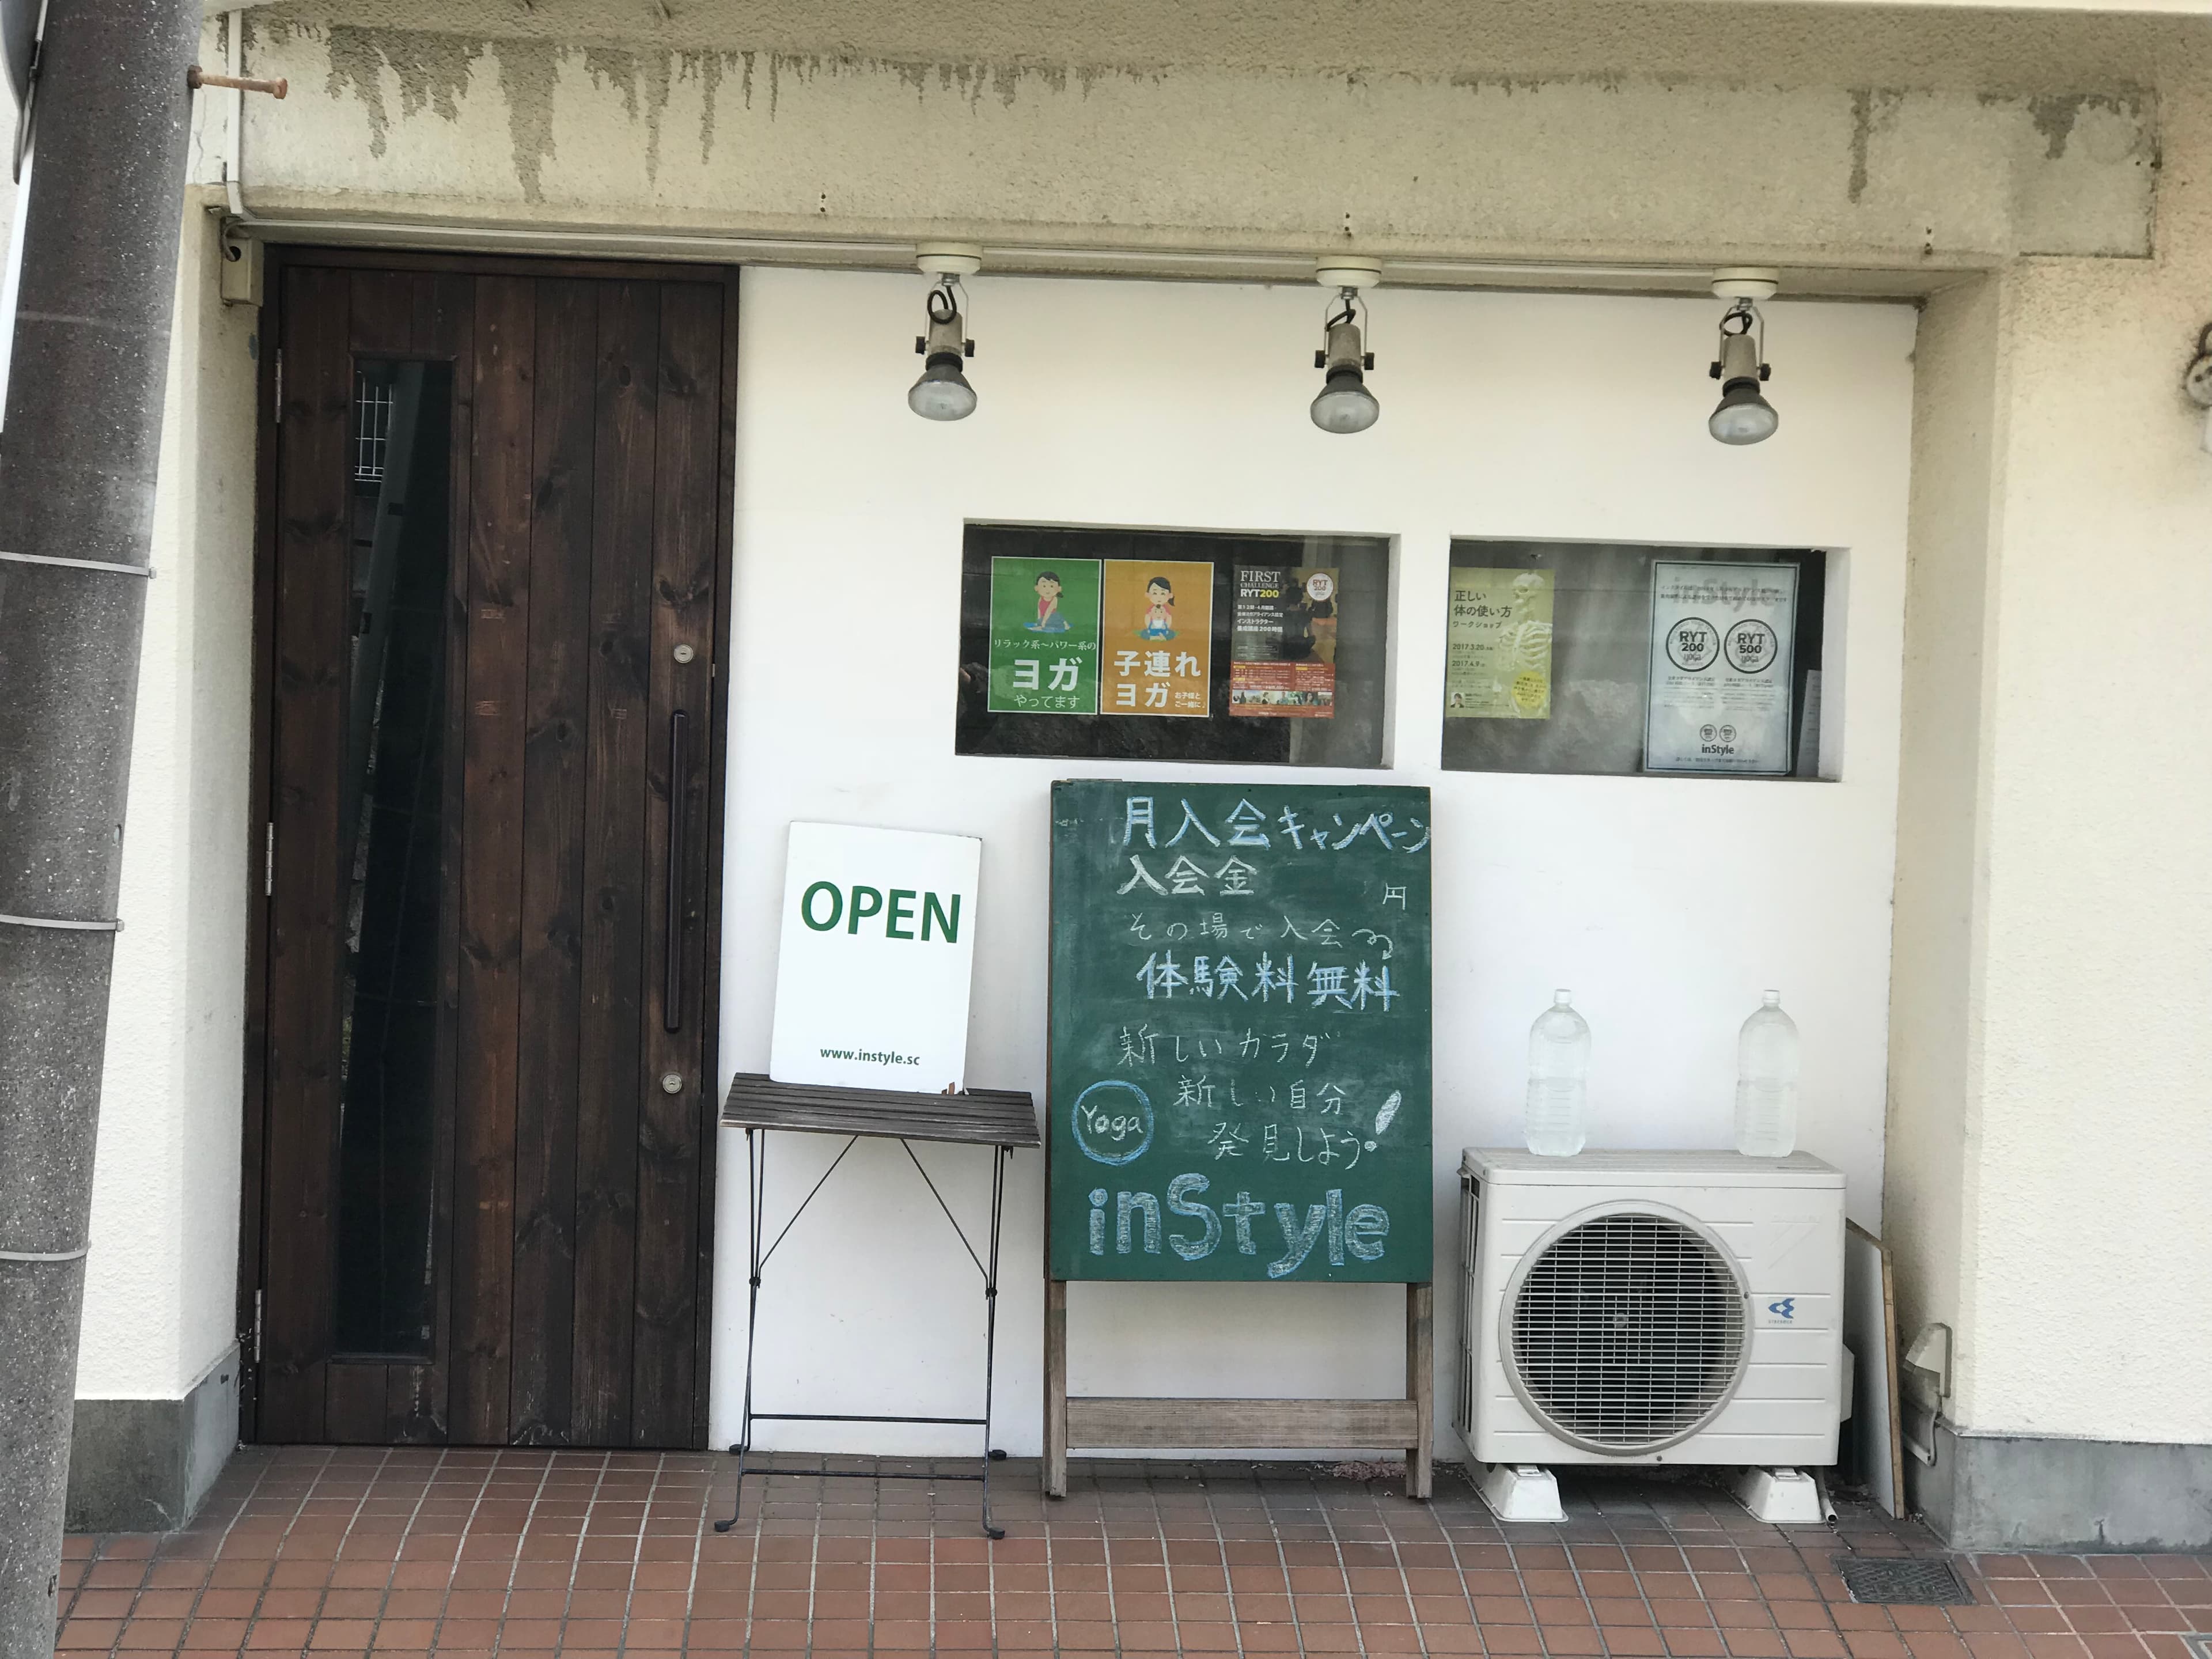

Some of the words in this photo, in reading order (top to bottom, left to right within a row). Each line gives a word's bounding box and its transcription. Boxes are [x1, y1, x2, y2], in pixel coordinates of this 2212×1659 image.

[1240, 570, 1281, 582] FIRST
[1240, 589, 1279, 598] RYT200
[1455, 590, 1487, 601] 正しい
[1453, 604, 1512, 618] 体の使い方
[1679, 631, 1707, 642] RYT
[1737, 633, 1765, 645] RYT
[1681, 643, 1704, 652] 200
[1739, 645, 1762, 654] 500
[1013, 657, 1082, 691] ヨガ
[1114, 650, 1201, 677] 子連れ
[1014, 695, 1080, 709] やってます
[1116, 682, 1171, 707] ヨガ
[1702, 744, 1734, 756] inStyle
[1123, 796, 1431, 853] 月入会キャンペーン
[1116, 855, 1257, 896] 入会金
[1382, 882, 1407, 910] 円
[801, 881, 961, 943] OPEN
[1135, 950, 1400, 1012] 体験料無料
[1117, 1023, 1331, 1067] 新しいカラダ
[820, 1048, 920, 1066] www.instyle.sc
[1173, 1075, 1346, 1114] 新しい自分
[1081, 1105, 1143, 1141] Yoga
[1088, 1173, 1390, 1278] inStyle
